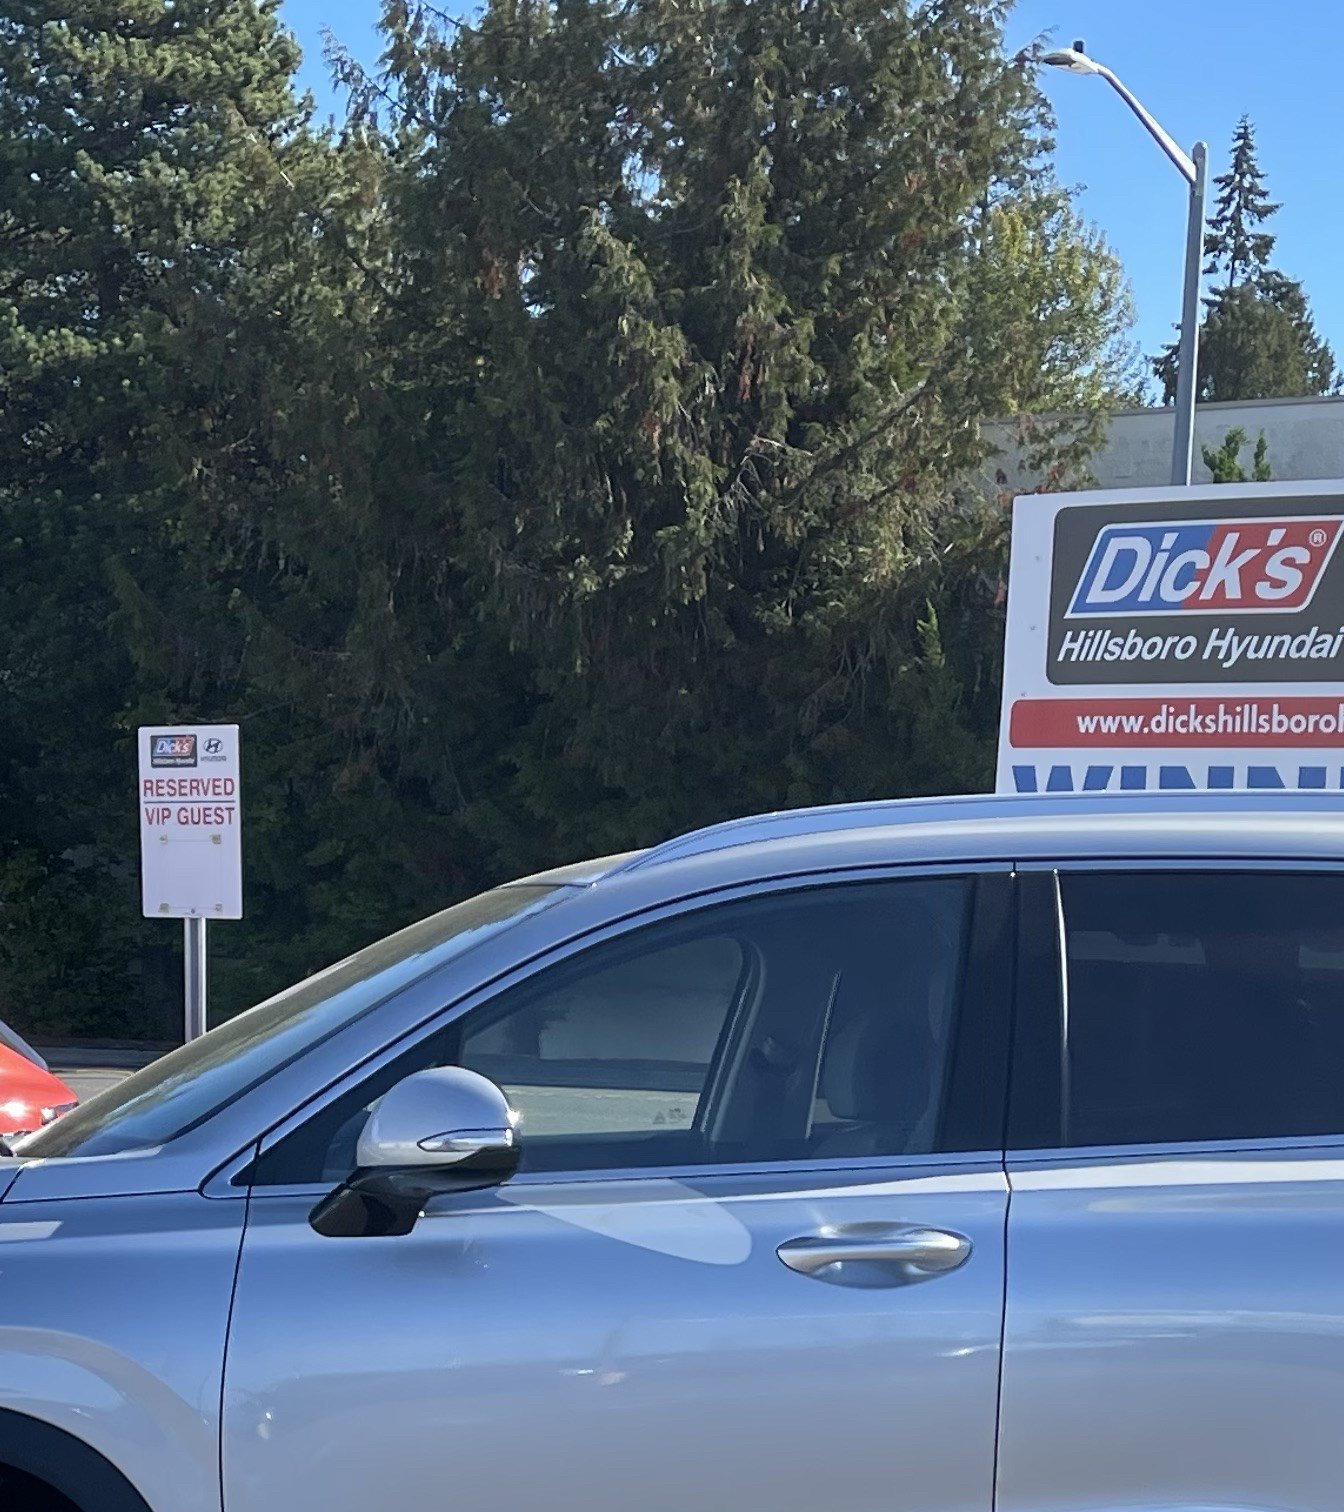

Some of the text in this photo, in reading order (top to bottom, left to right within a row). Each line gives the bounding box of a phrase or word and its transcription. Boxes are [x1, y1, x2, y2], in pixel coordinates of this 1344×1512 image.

[1057, 628, 1197, 662] Hillsboro
[143, 778, 235, 797] RESERVED
[144, 807, 236, 825] VIP GUEST
